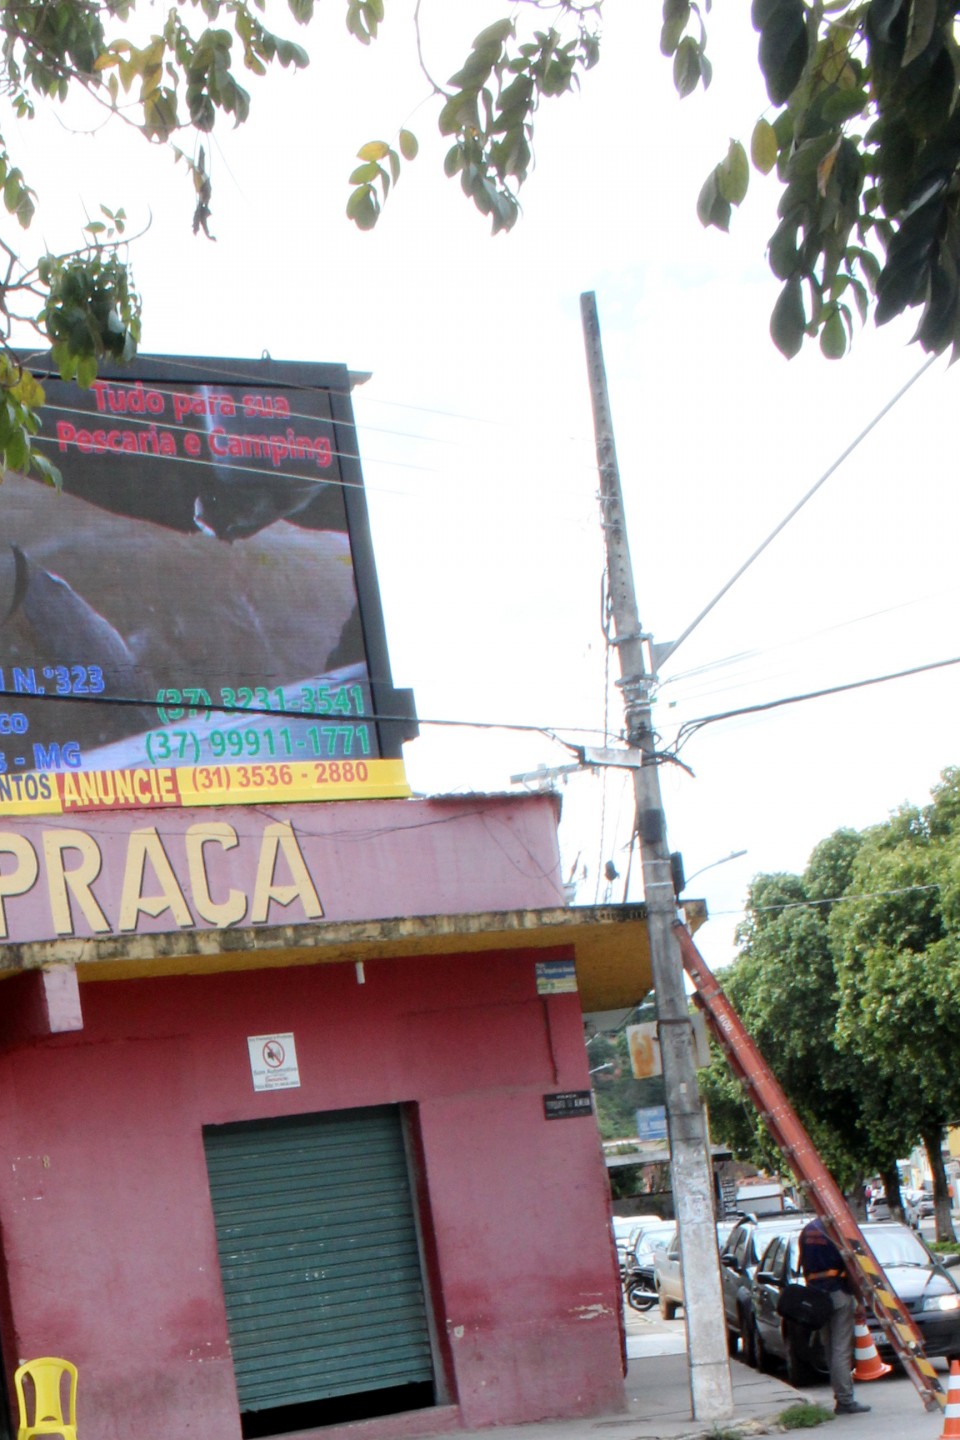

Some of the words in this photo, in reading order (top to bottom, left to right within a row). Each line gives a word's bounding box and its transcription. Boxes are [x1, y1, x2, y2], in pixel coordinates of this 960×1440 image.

[91, 382, 165, 413] Tudo
[171, 392, 235, 423] para
[242, 393, 290, 418] sua
[55, 420, 178, 456] Pescaria
[183, 433, 202, 456] e
[206, 425, 333, 468] Camping
[155, 687, 213, 724] (37)
[219, 683, 366, 718] 3231-3541
[32, 741, 84, 771] MG
[145, 728, 201, 764] (37)
[209, 724, 372, 758] 99911-1771
[63, 767, 177, 808] ANUNCIE
[191, 766, 231, 792] (31)
[237, 764, 294, 789] 3536
[316, 760, 369, 785] 2880
